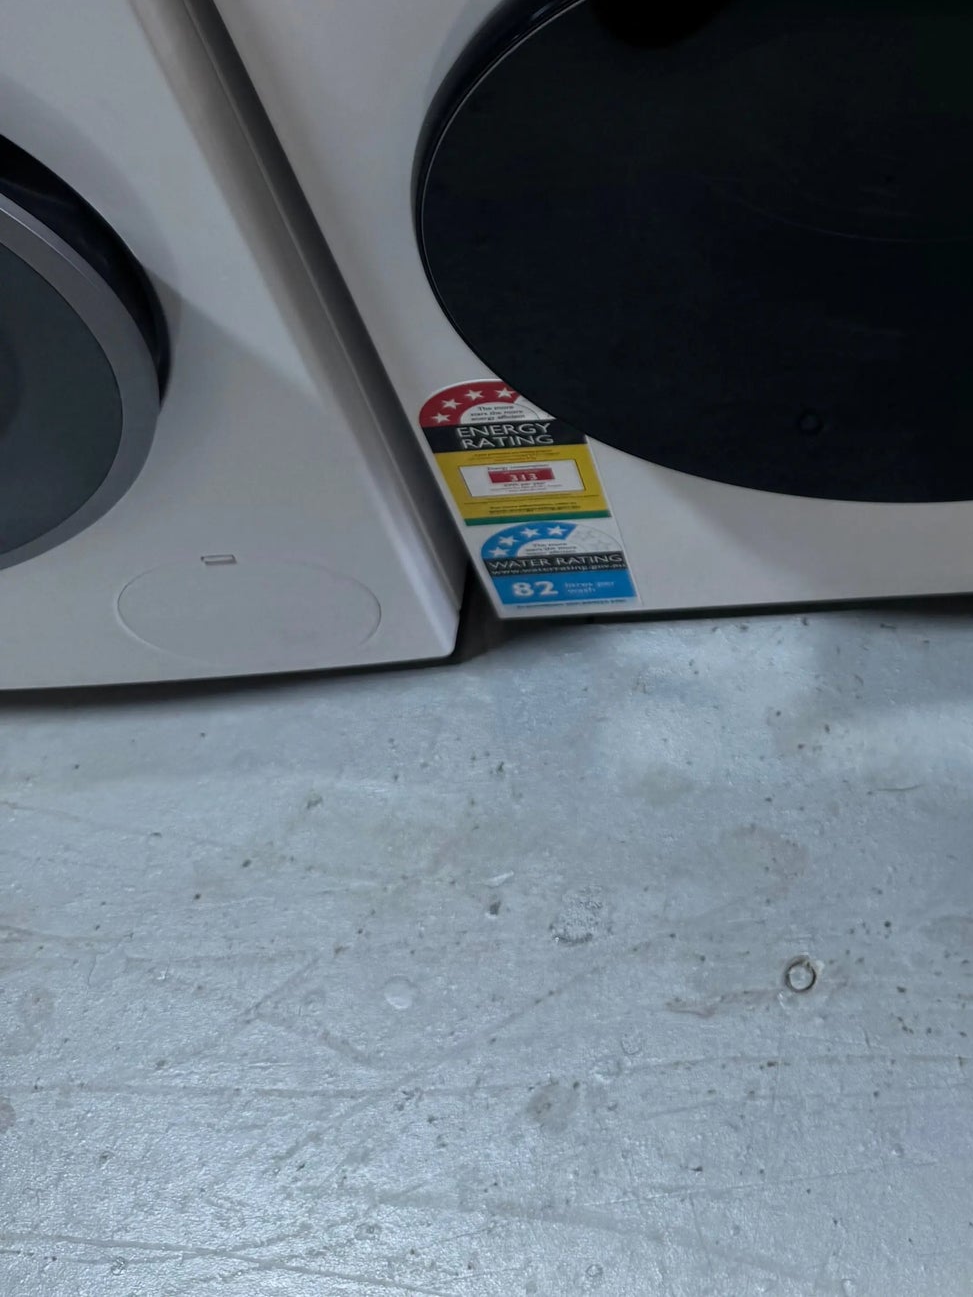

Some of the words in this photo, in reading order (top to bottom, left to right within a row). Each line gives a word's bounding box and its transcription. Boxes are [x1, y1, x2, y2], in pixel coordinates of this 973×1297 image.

[456, 422, 551, 438] ENERGY
[461, 434, 555, 449] RATING
[488, 557, 551, 569] WATER
[556, 553, 623, 565] RATING
[511, 580, 559, 597] 82
